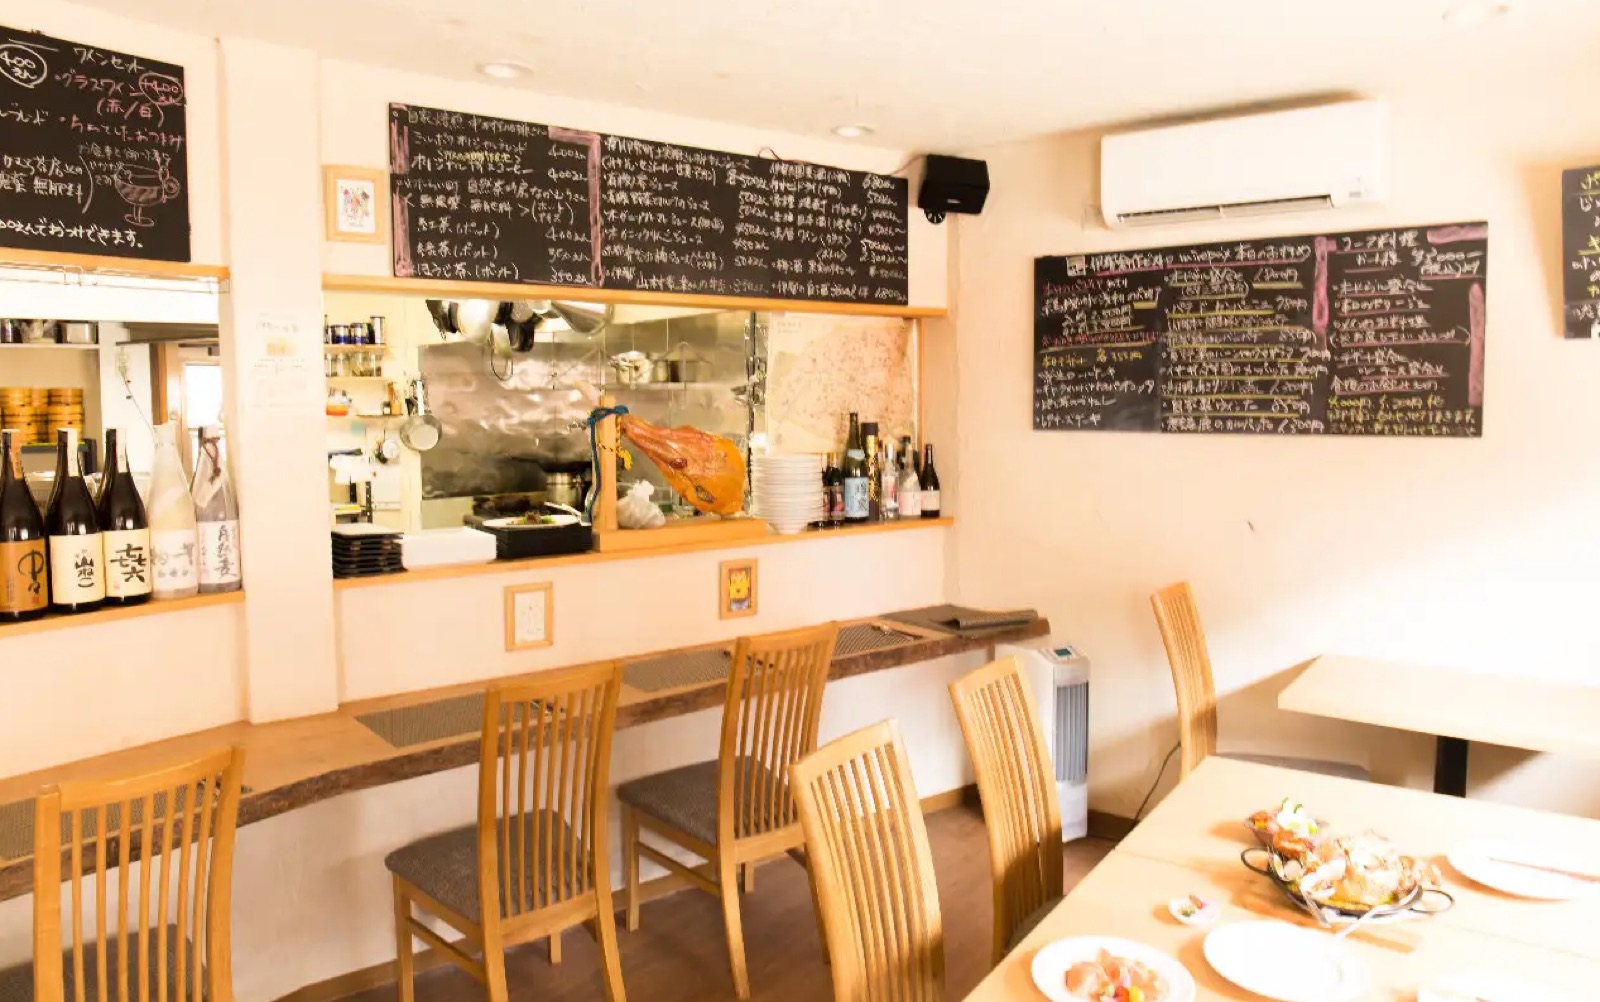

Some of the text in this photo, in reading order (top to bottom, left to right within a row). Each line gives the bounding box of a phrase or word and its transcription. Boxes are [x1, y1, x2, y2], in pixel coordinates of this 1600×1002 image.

[73, 48, 146, 73] ワインセット
